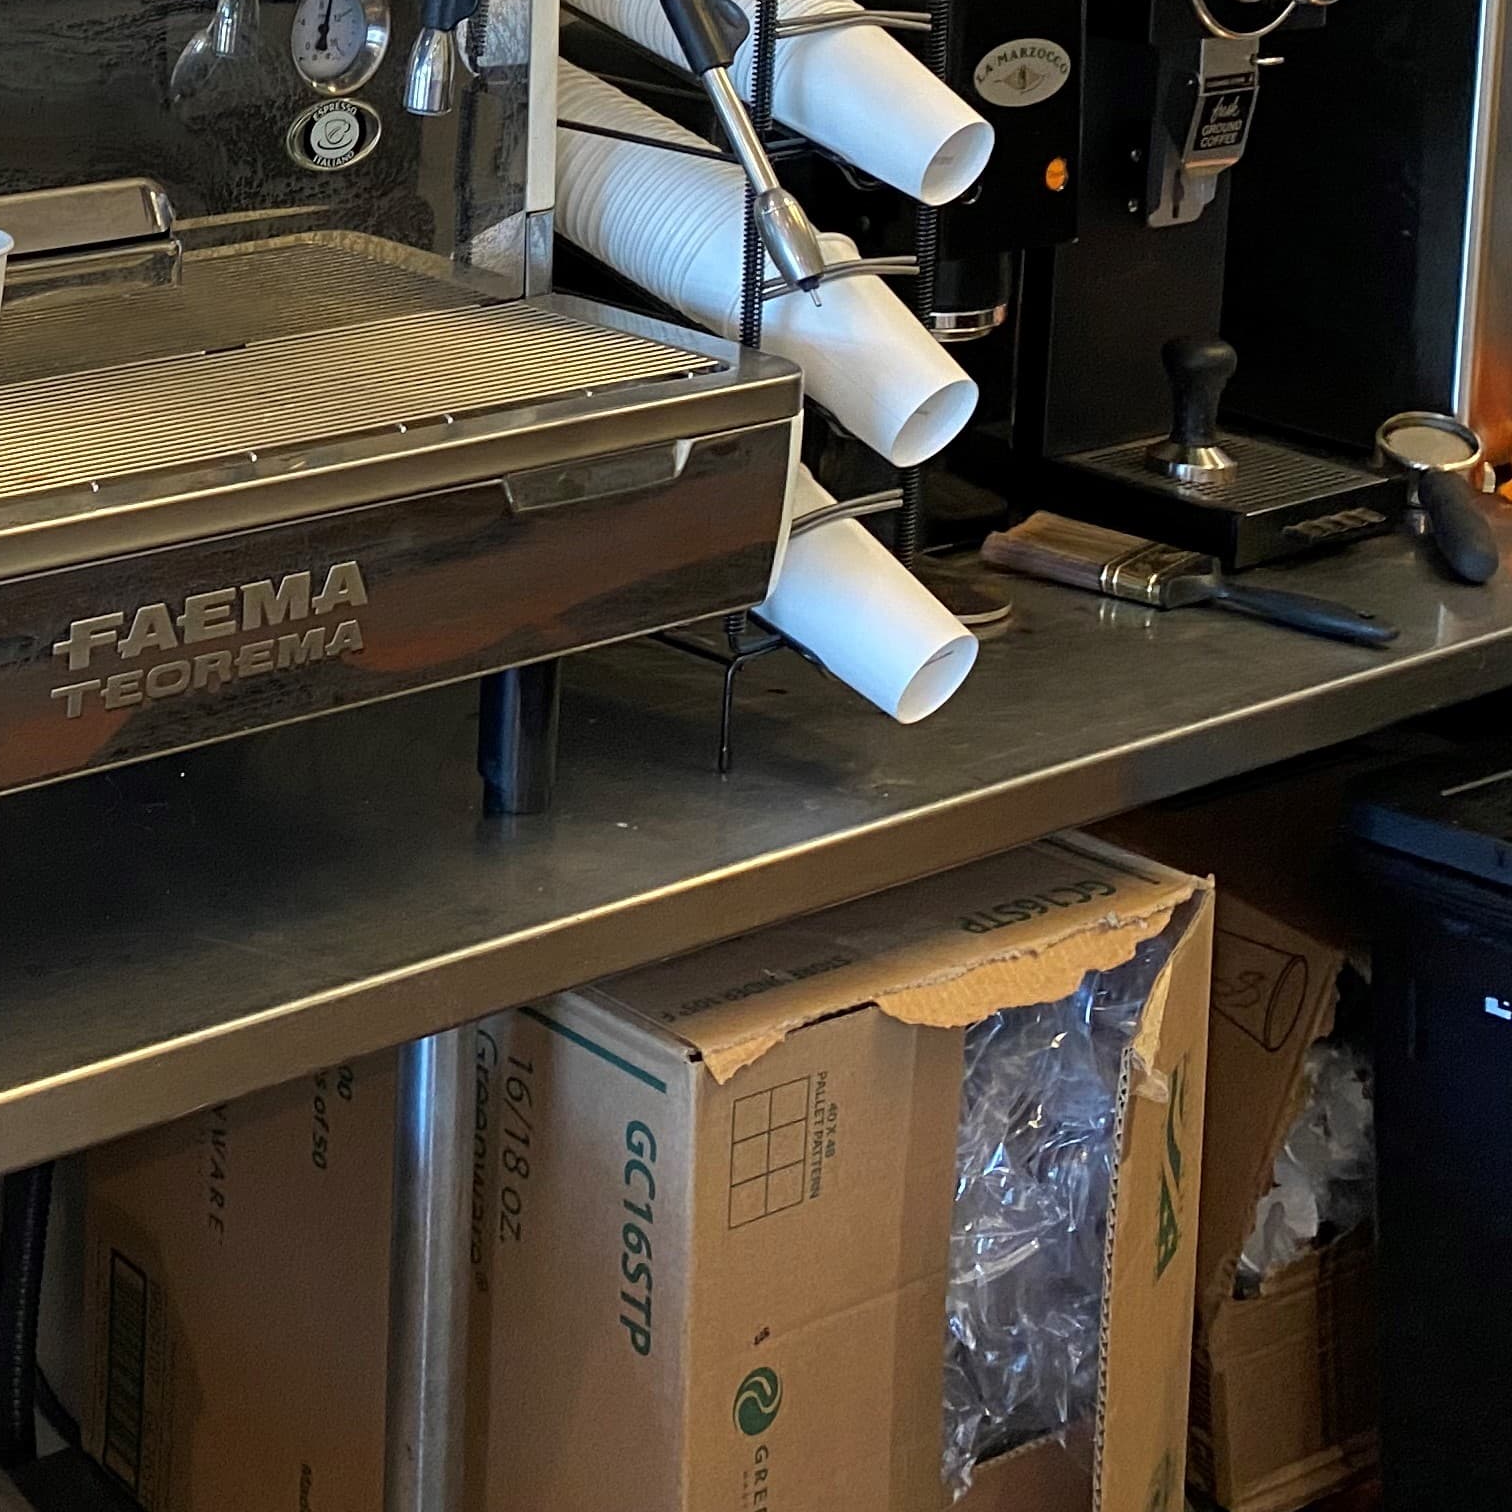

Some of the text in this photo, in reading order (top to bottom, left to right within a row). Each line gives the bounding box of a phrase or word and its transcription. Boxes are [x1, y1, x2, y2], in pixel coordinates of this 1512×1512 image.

[313, 100, 357, 121] ESPRESSO
[996, 46, 1069, 76] MARZOCCO
[313, 150, 356, 169] ITALIANO
[53, 560, 368, 671] FAEMA
[50, 619, 364, 719] TEOREMA
[960, 879, 1117, 935] GC16STP
[502, 1055, 537, 1180] 16/18
[808, 1070, 830, 1201] PALLET PATTERN
[619, 1119, 657, 1357] GC16STP
